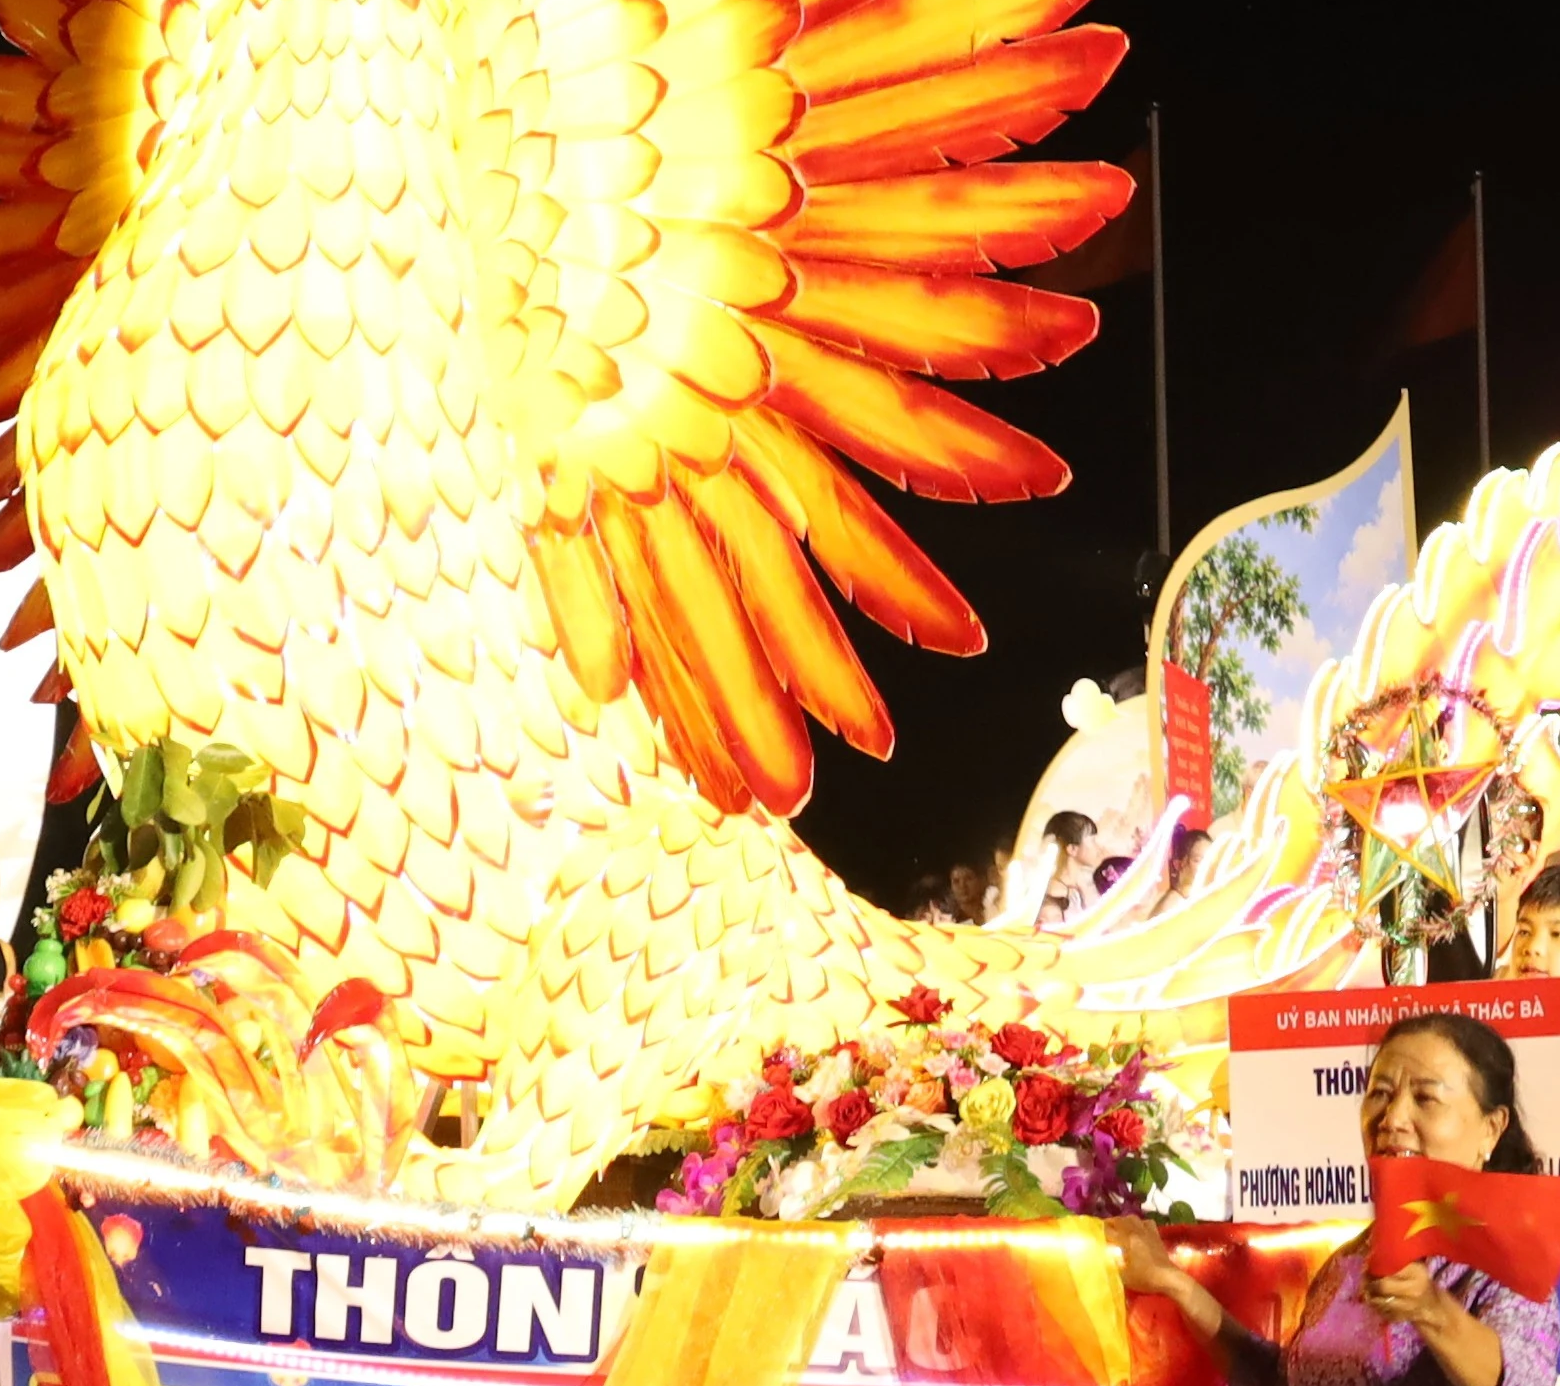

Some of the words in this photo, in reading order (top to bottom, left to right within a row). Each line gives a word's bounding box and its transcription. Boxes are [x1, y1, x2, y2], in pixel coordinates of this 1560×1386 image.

[1304, 1010, 1340, 1028] BAN
[1345, 1002, 1392, 1026] NHÂN
[1467, 997, 1514, 1020] THÁC
[1520, 995, 1544, 1019] BÀ
[1313, 1059, 1371, 1096] THÔN
[1239, 1163, 1300, 1215] PHƯỢNG
[1305, 1158, 1355, 1205] HOÀNG
[243, 1243, 599, 1358] THÔN
